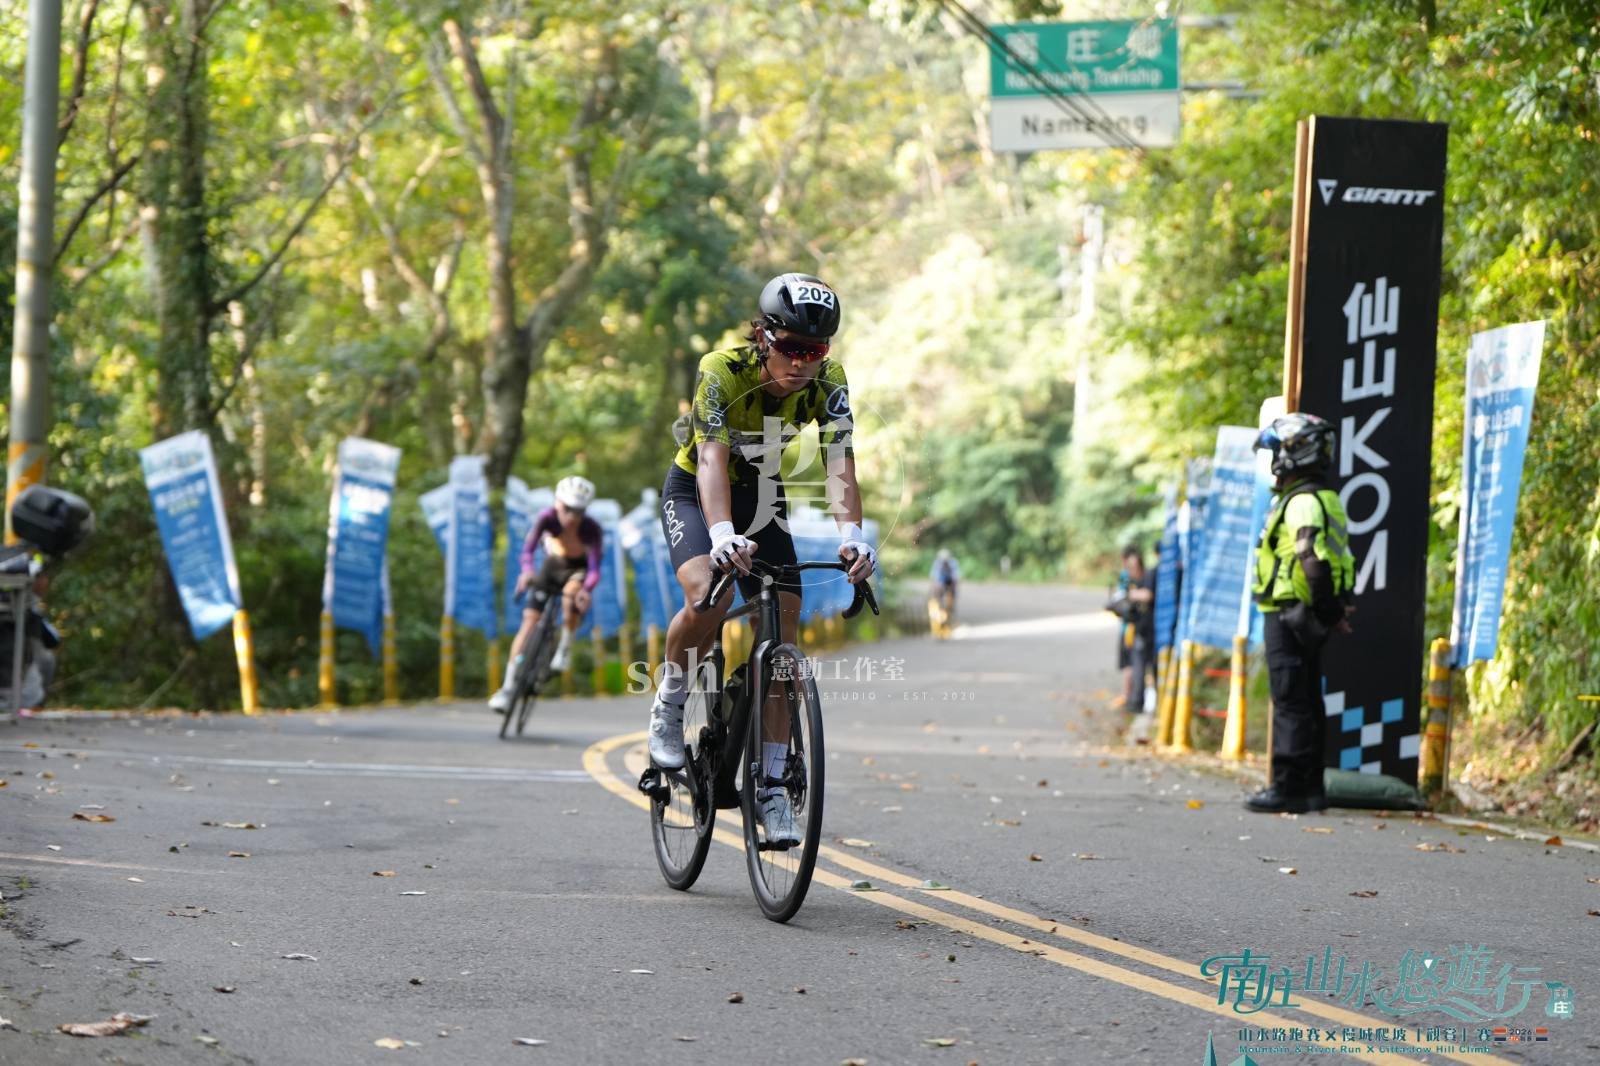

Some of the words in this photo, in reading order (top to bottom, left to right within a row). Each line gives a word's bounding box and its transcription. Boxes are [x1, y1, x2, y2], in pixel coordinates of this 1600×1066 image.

[1341, 186, 1436, 206] GIANT
[798, 286, 833, 306] 202
[663, 500, 685, 548] pedla
